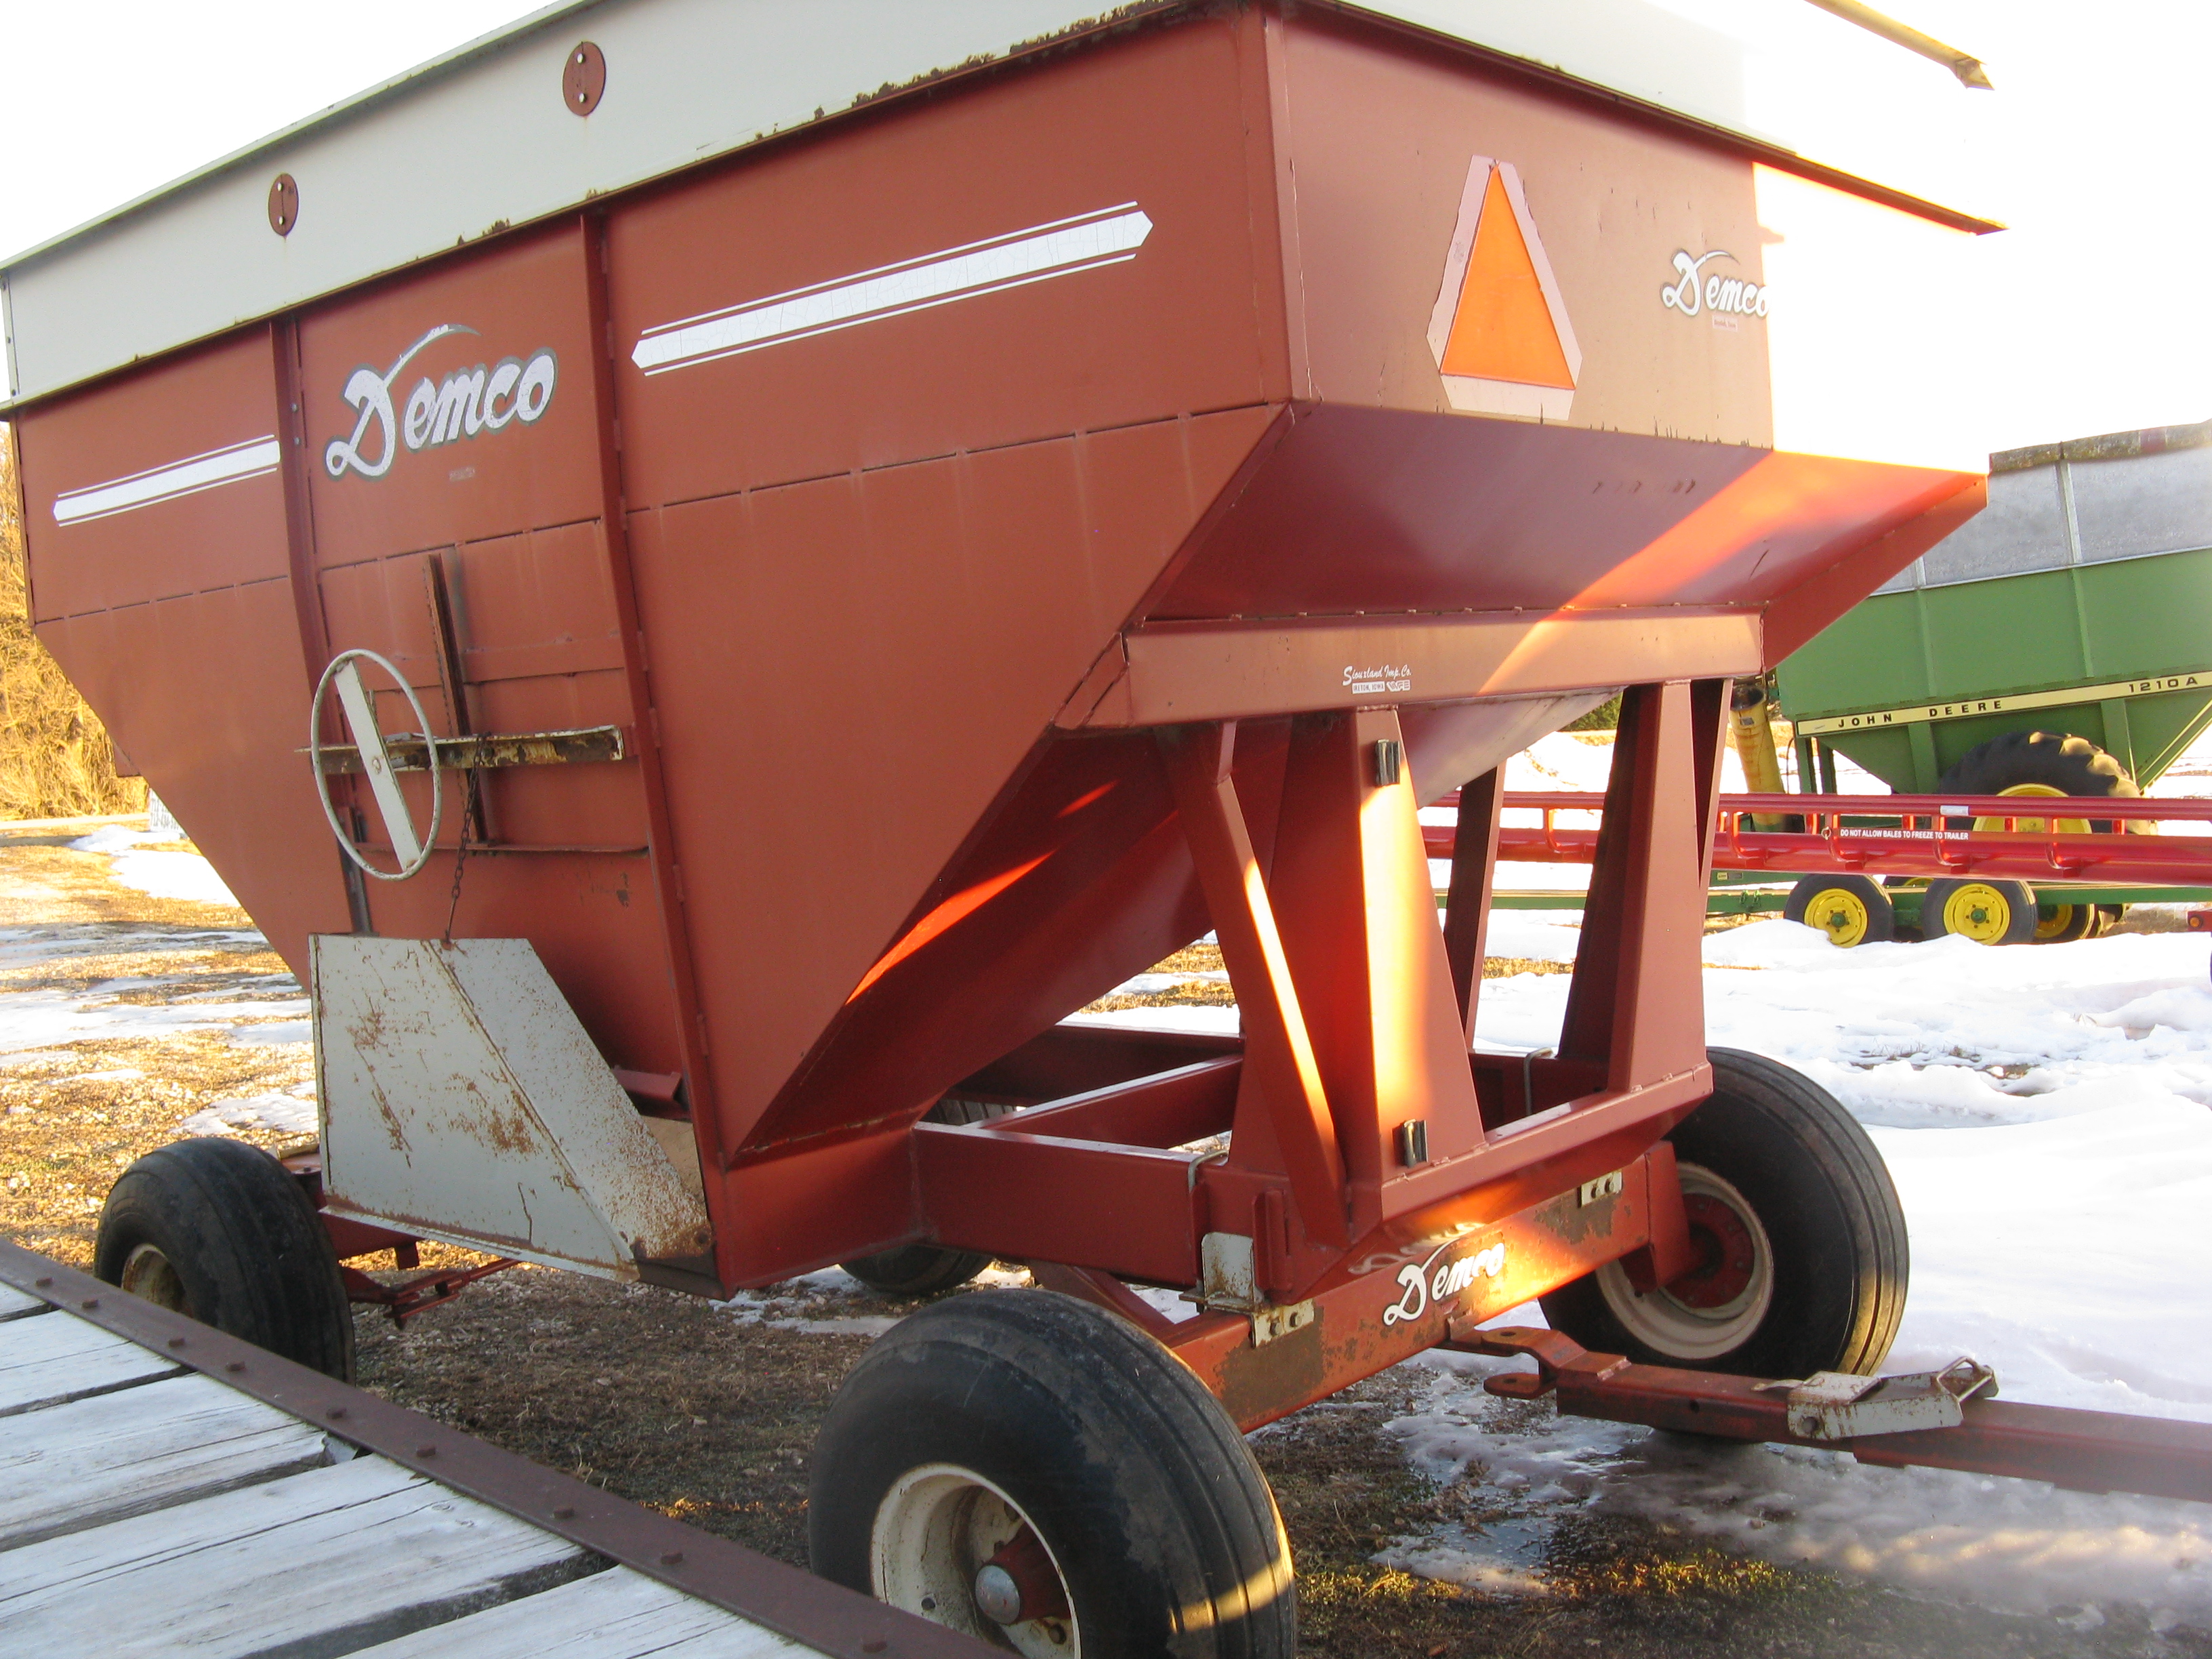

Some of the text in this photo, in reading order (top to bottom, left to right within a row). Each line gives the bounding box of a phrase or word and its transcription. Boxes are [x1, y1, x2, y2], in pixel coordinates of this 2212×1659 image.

[1660, 249, 1770, 317] Demco
[325, 324, 557, 480] Demco
[2129, 676, 2198, 693] 1210A
[1839, 700, 2002, 728] JOHN DEERE
[1840, 829, 1969, 840] DO NOT ALLOW BALES TO FREEZE TO TRAILER
[1382, 1237, 1505, 1326] Demco
